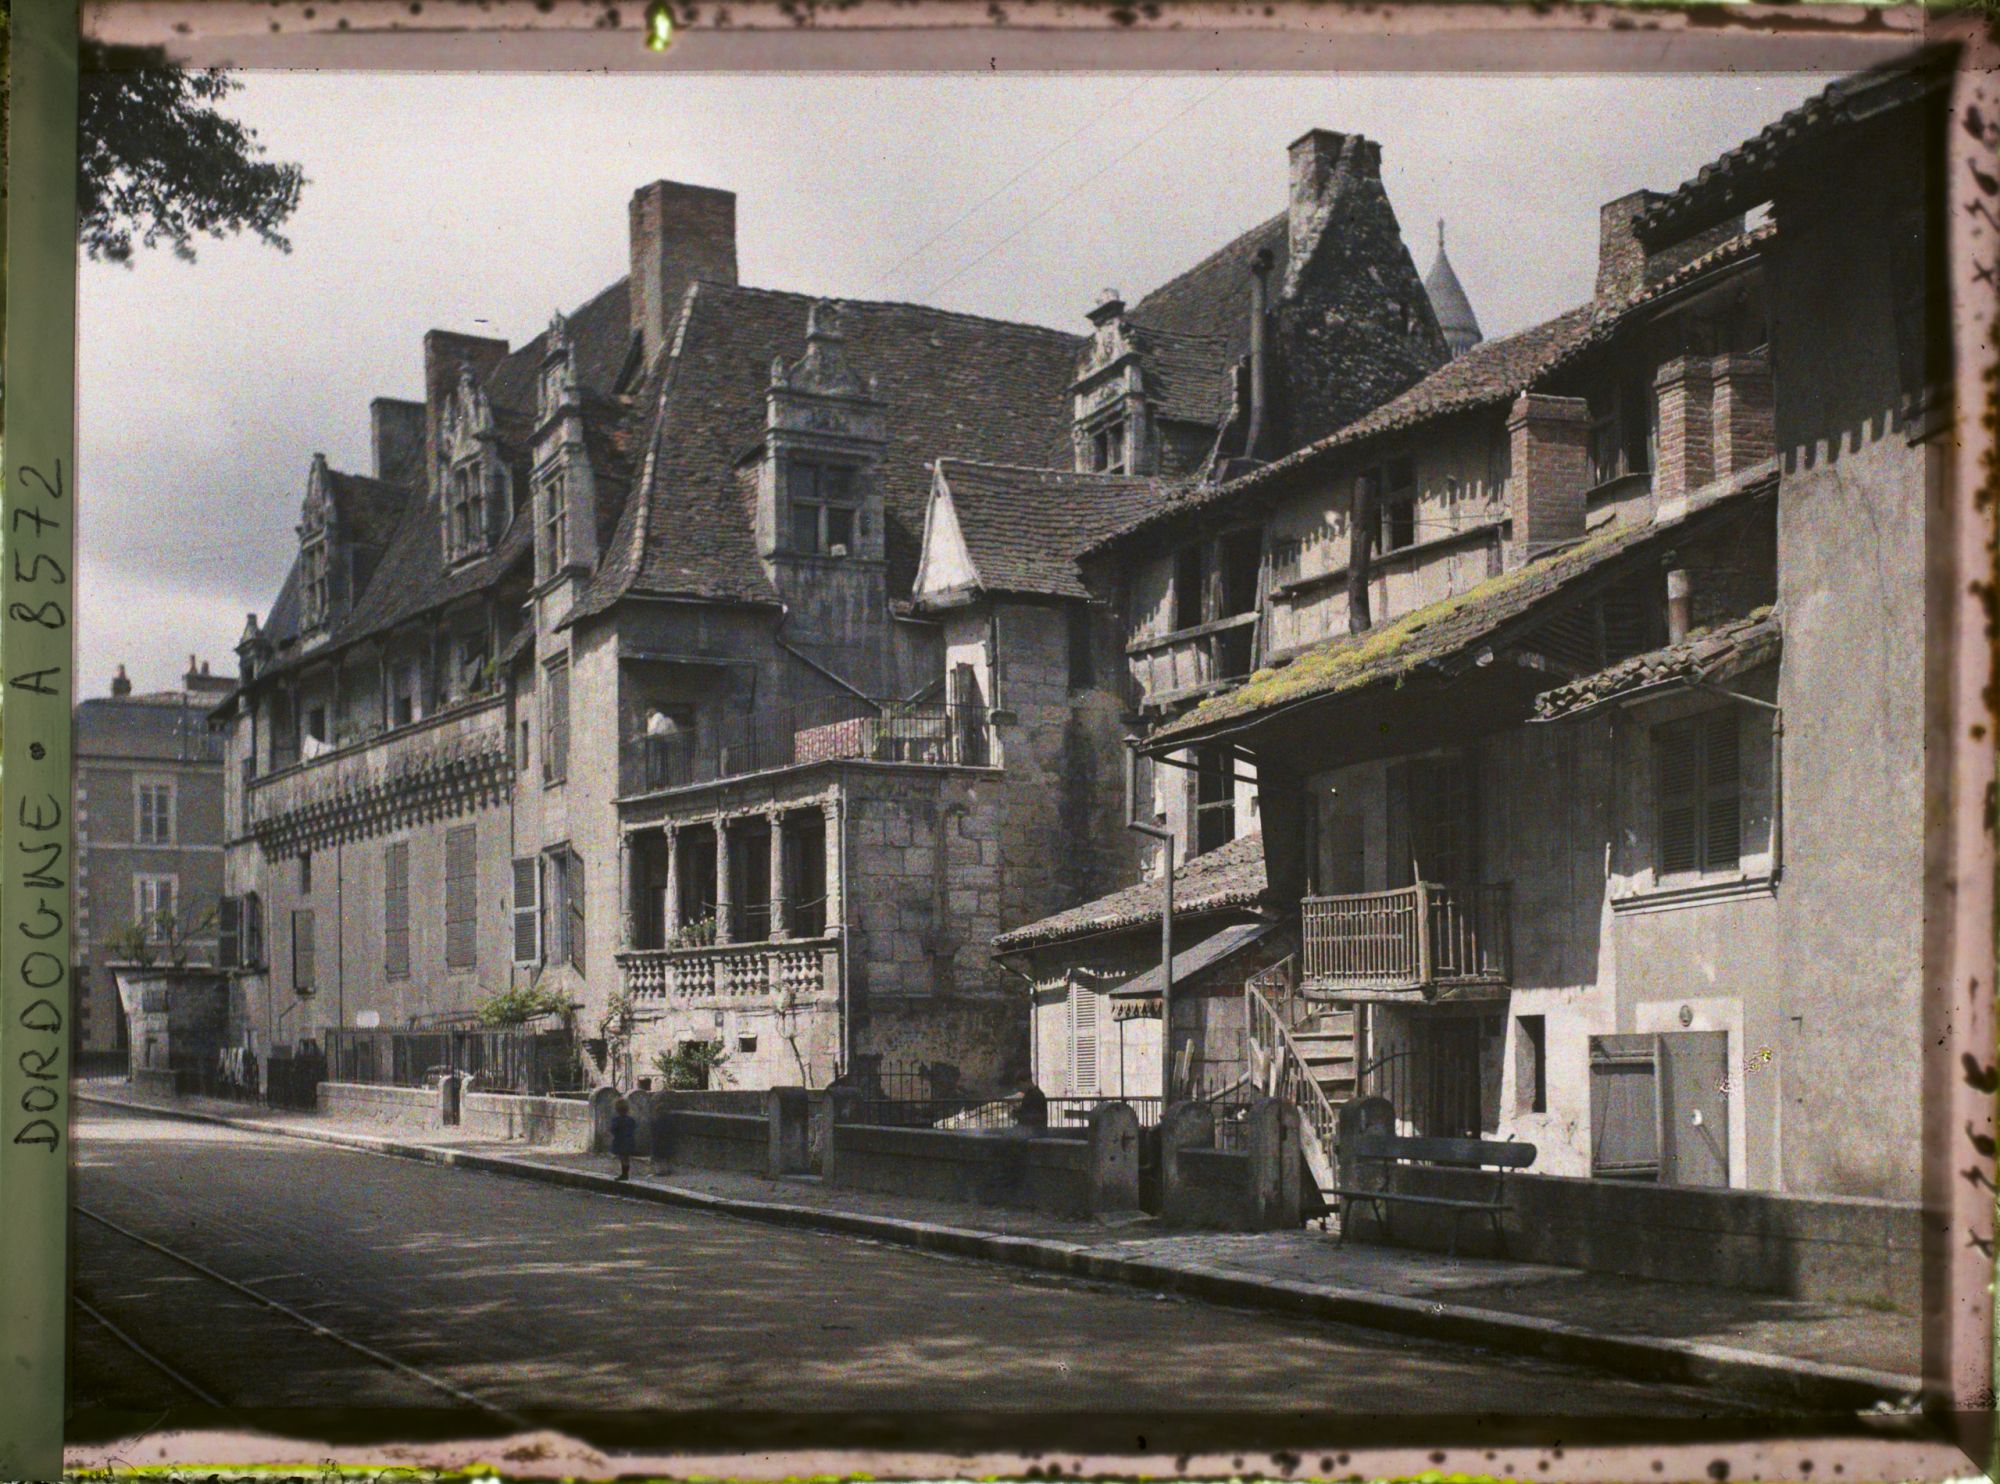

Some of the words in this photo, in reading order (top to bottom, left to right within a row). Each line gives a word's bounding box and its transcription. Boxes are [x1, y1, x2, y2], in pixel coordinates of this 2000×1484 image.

[9, 458, 64, 630] 8572
[8, 666, 61, 696] A
[12, 793, 64, 1154] DORDOGNE
